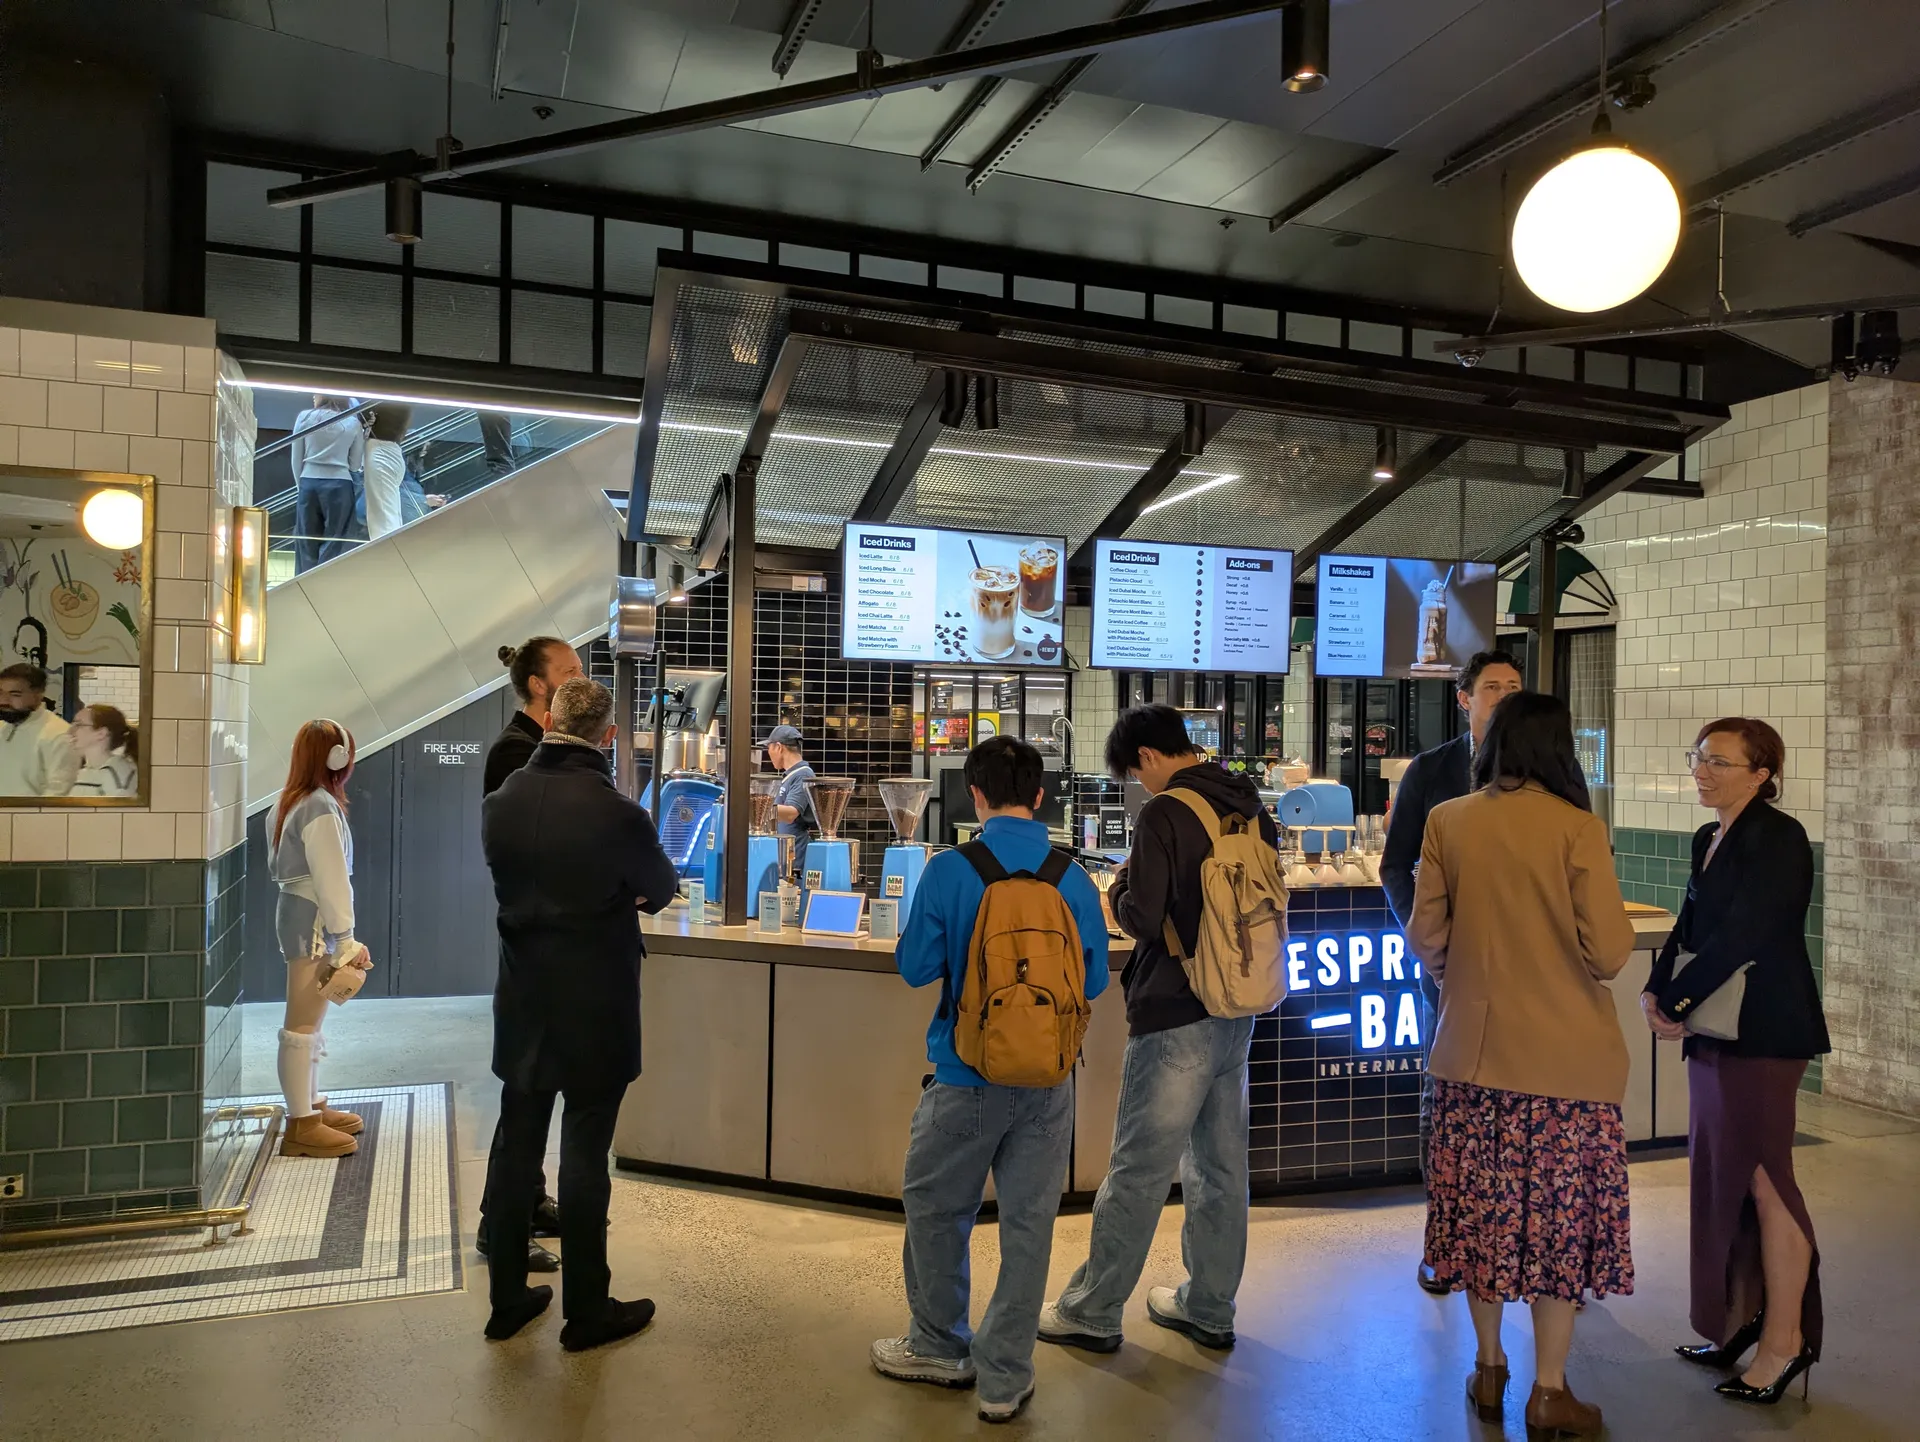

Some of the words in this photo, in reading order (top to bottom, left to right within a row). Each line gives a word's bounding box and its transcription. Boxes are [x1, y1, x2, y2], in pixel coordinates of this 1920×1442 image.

[863, 537, 882, 546] Iced
[884, 538, 912, 548] Drinks
[1131, 554, 1156, 563] Drinks
[1229, 560, 1260, 569] Add-ons
[1332, 567, 1371, 576] Milkshakes
[424, 744, 447, 753] FIRE
[450, 744, 480, 753] HOSE
[439, 755, 465, 764] REEL
[1286, 934, 1421, 991] ESPR
